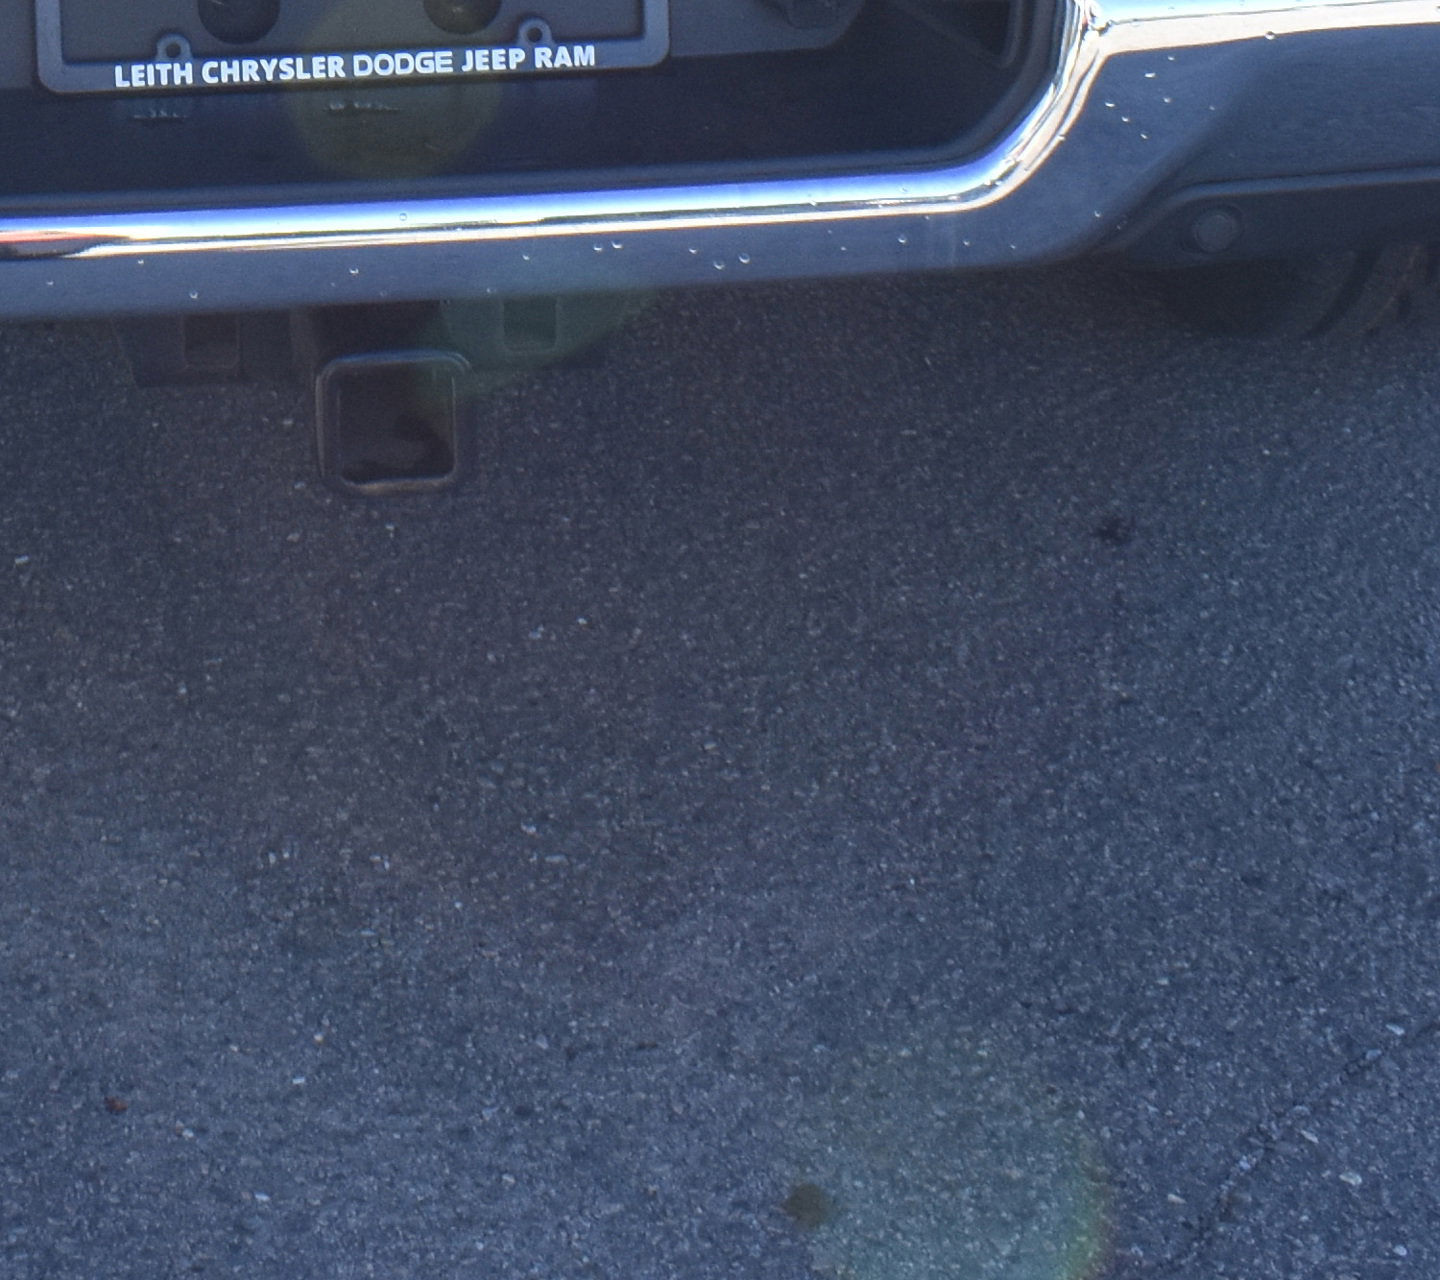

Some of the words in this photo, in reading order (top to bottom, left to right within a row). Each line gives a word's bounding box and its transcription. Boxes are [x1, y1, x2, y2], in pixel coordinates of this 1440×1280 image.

[114, 60, 194, 88] LEITH
[200, 56, 347, 85] CHRYSLER
[352, 50, 454, 78] DODGE
[460, 47, 526, 73] JEEP
[533, 44, 597, 69] RAM
